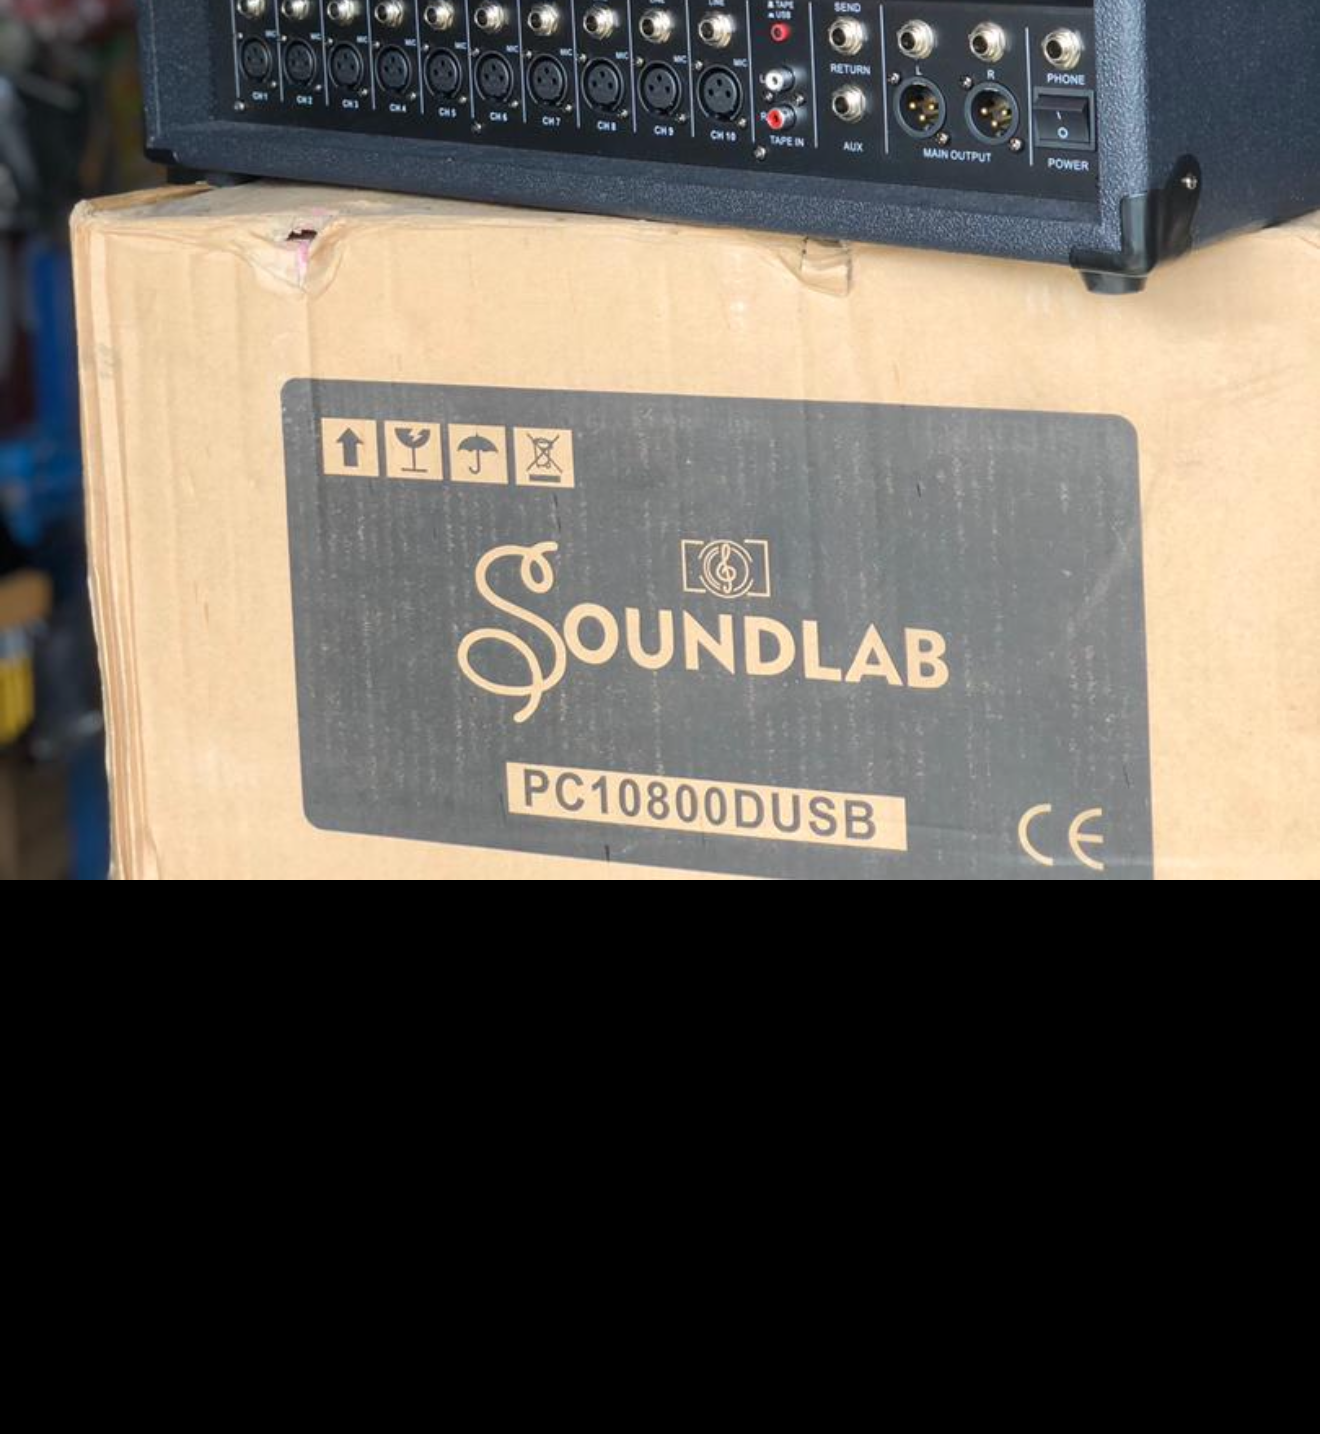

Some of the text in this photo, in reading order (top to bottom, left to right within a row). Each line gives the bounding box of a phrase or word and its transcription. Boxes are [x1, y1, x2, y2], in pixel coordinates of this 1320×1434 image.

[775, 0, 794, 9] TAPE
[834, 2, 861, 13] SEND
[776, 11, 791, 19] USB
[830, 63, 871, 75] RETURN
[987, 69, 995, 80] R
[1047, 73, 1085, 85] PHONE
[770, 135, 804, 147] TAPE IN
[843, 141, 864, 152] AUX
[923, 147, 992, 162] MAIN OUTPUT
[1047, 158, 1089, 171] POWER
[457, 540, 950, 723] SOUNDLAB
[522, 768, 877, 841] PC10800DUSB
